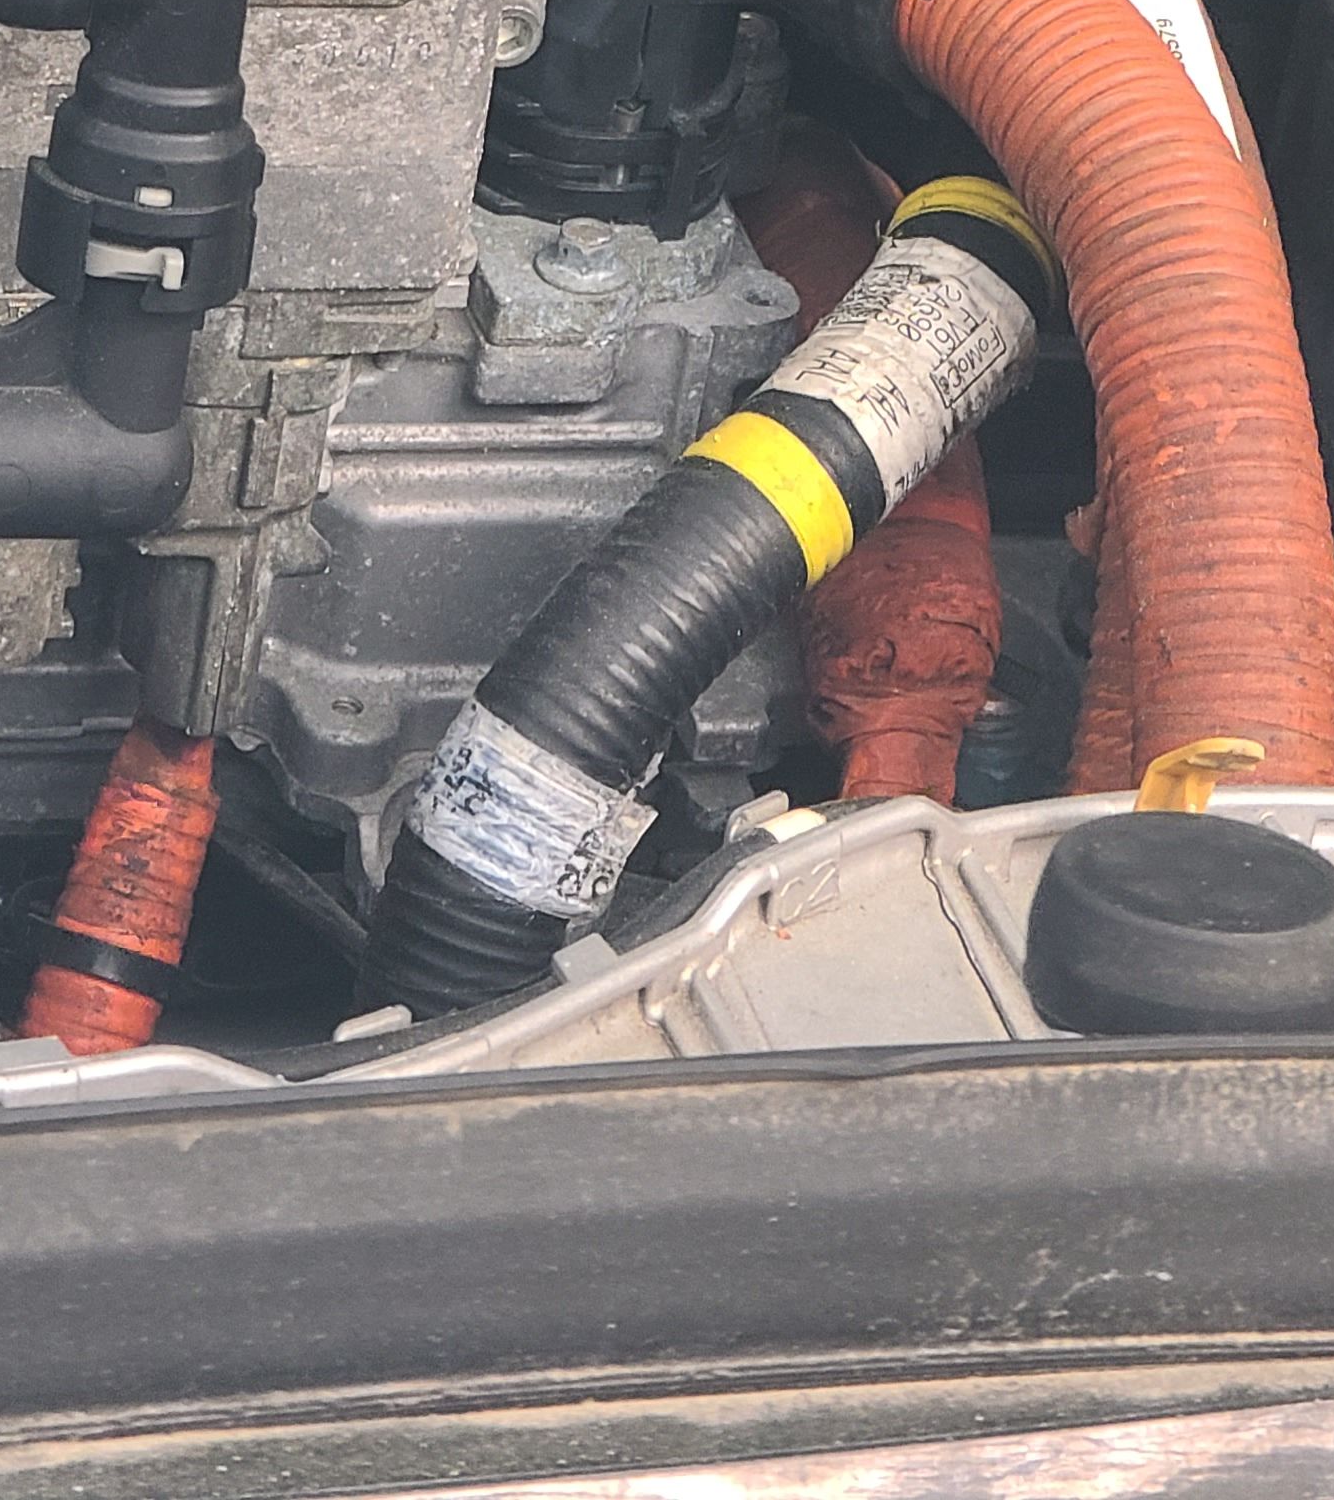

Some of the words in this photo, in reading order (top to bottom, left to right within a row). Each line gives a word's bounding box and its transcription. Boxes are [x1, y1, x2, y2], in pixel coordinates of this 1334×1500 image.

[927, 306, 981, 358] FV6T
[795, 347, 862, 384] AAL
[937, 326, 1001, 396] FoMoCo
[857, 374, 911, 436] AAL
